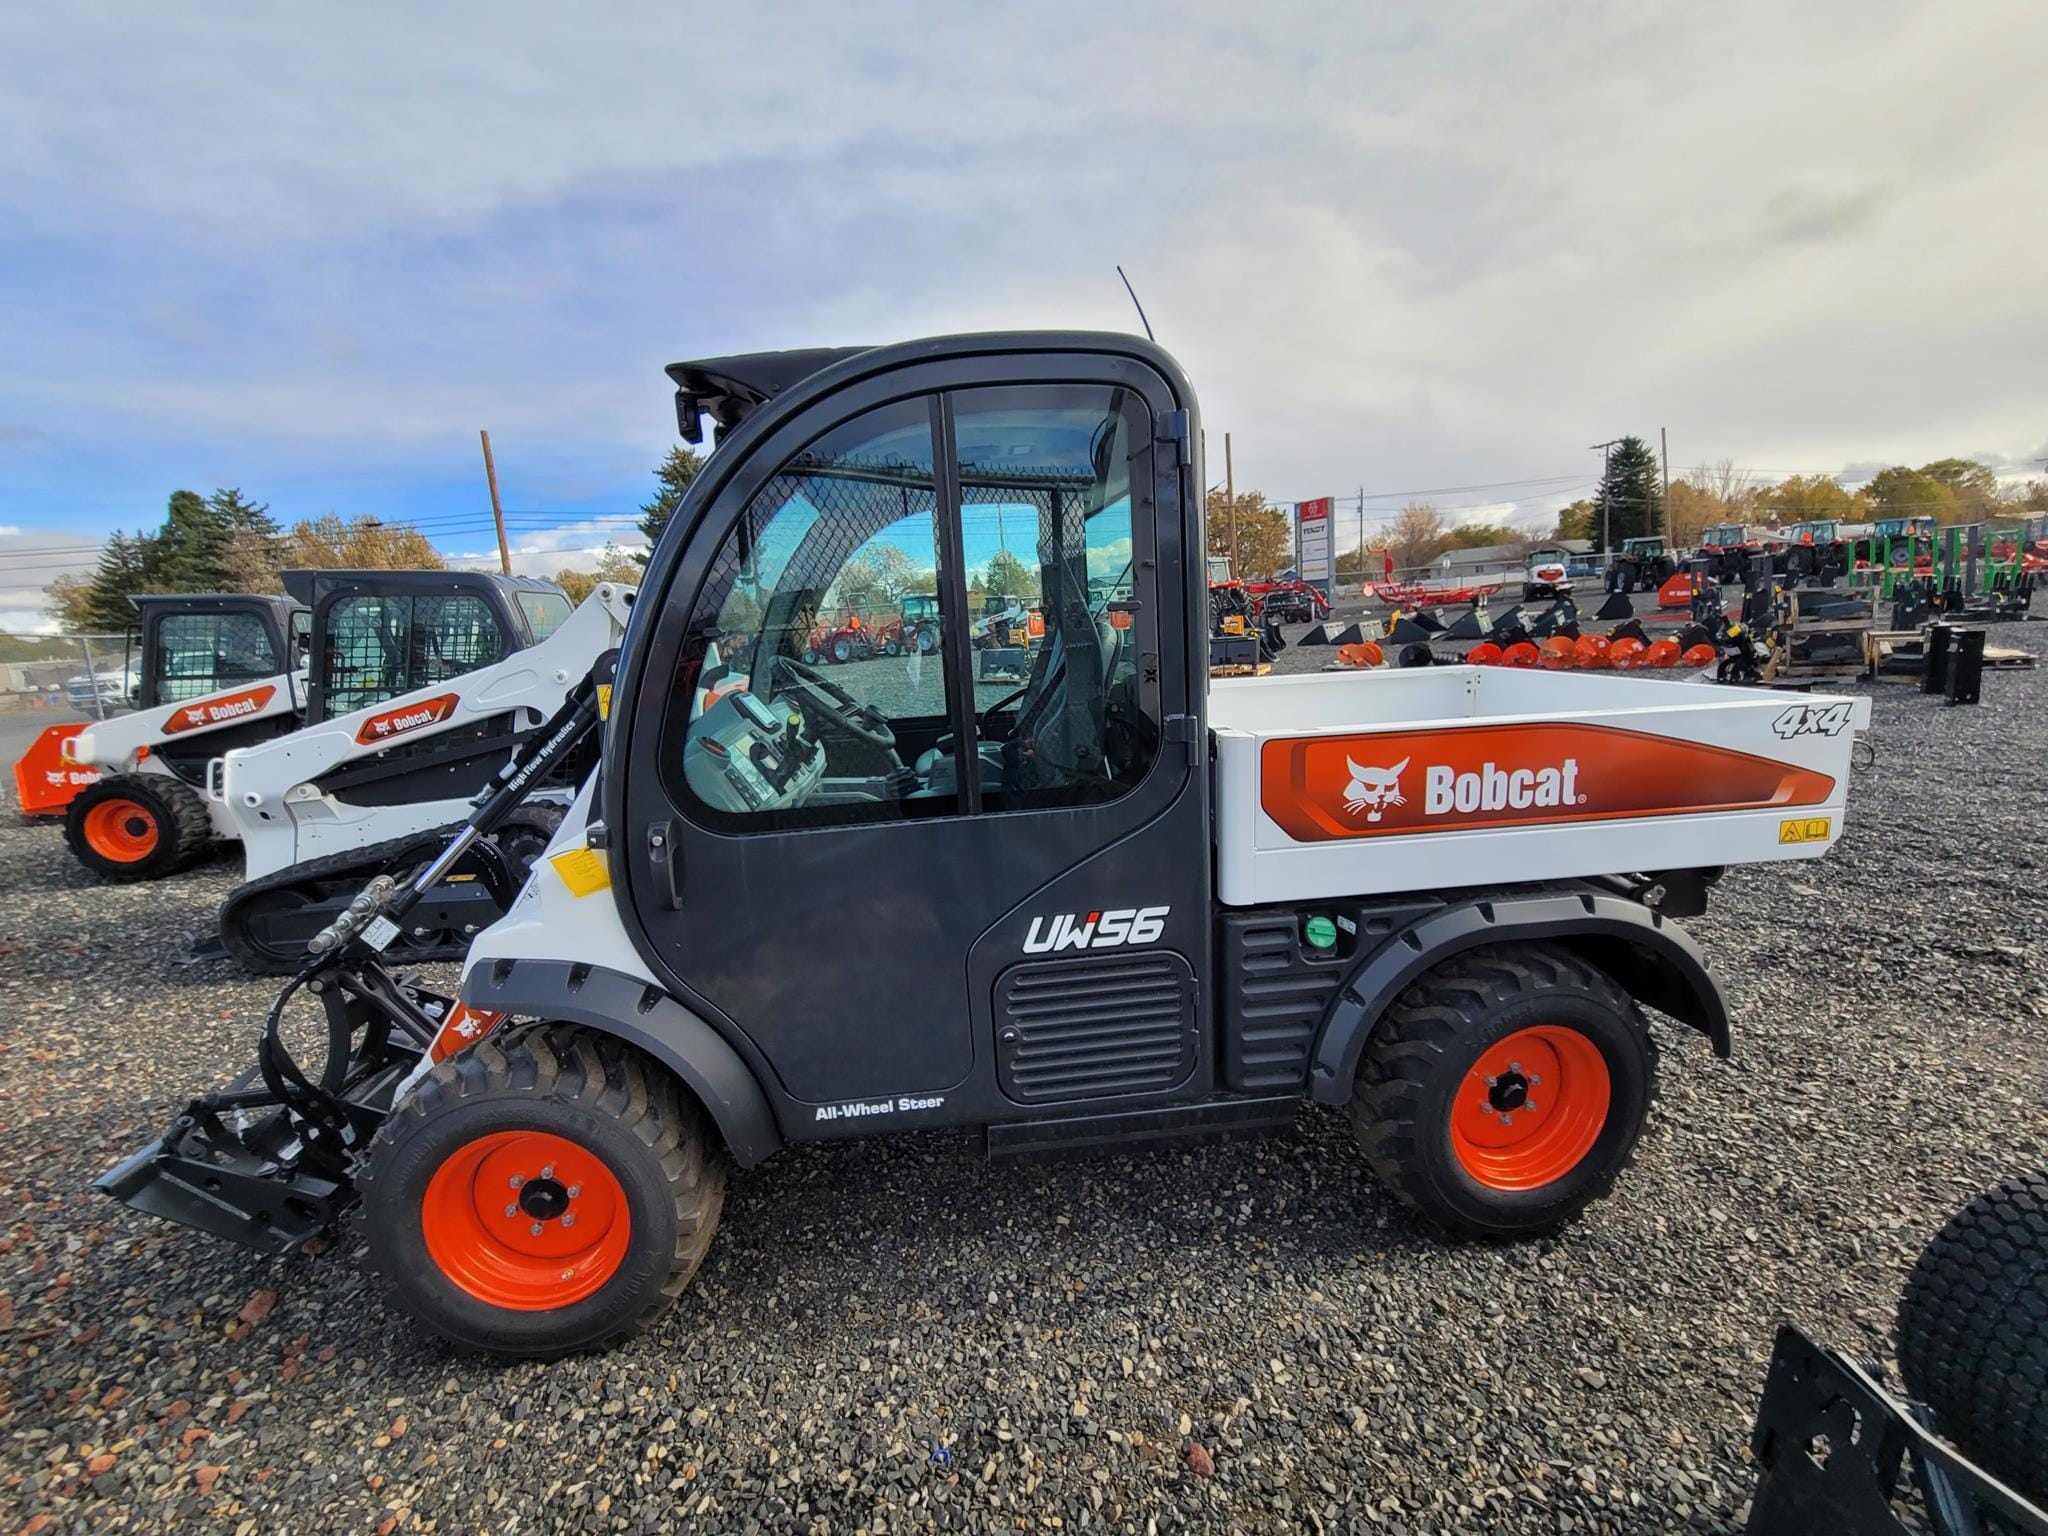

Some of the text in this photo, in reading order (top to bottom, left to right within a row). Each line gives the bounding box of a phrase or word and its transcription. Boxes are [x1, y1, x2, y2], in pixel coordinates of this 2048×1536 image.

[209, 698, 257, 720] Bobcat
[393, 709, 433, 730] Bobcat
[1772, 703, 1853, 739] 4x4
[507, 720, 576, 791] High Flow Hydraulics
[1425, 759, 1578, 815] Bobcat
[1022, 906, 1170, 953] UW56
[815, 1097, 944, 1120] All-Wheel Steer
